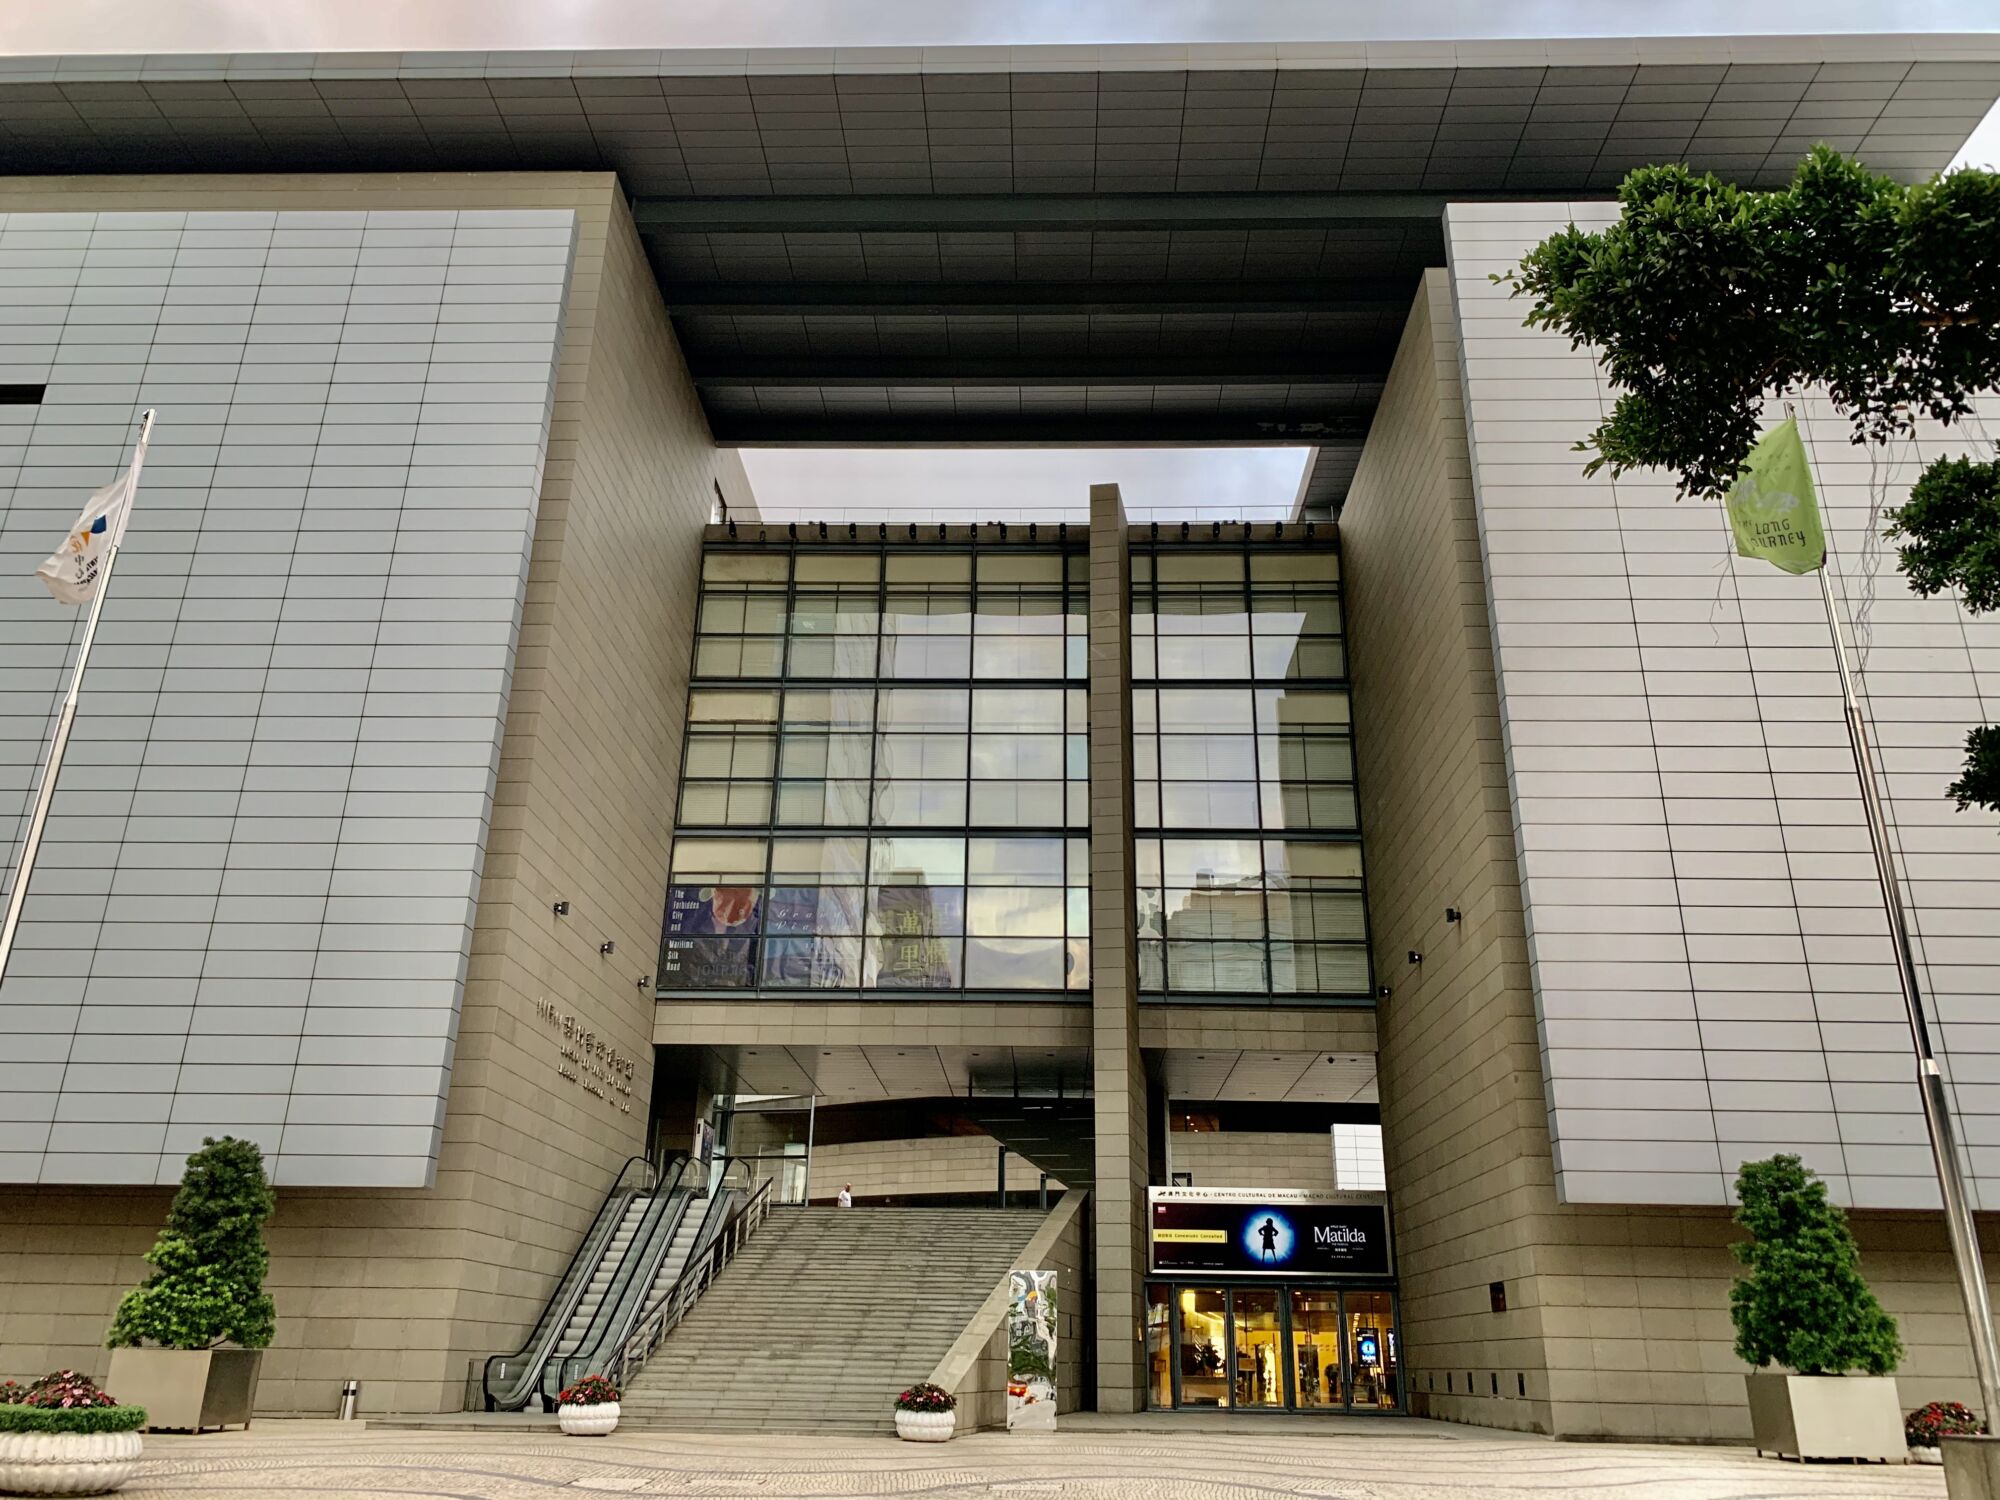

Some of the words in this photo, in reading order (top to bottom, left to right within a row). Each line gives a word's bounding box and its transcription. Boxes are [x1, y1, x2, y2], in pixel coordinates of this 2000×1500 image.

[1755, 518, 1790, 535] LONG
[675, 889, 685, 899] The
[673, 900, 700, 910] Forbidden
[671, 911, 684, 921] City
[669, 940, 694, 949] Maritime
[667, 951, 679, 960] Silk
[666, 962, 681, 971] Road
[1313, 1226, 1367, 1243] Matilda
